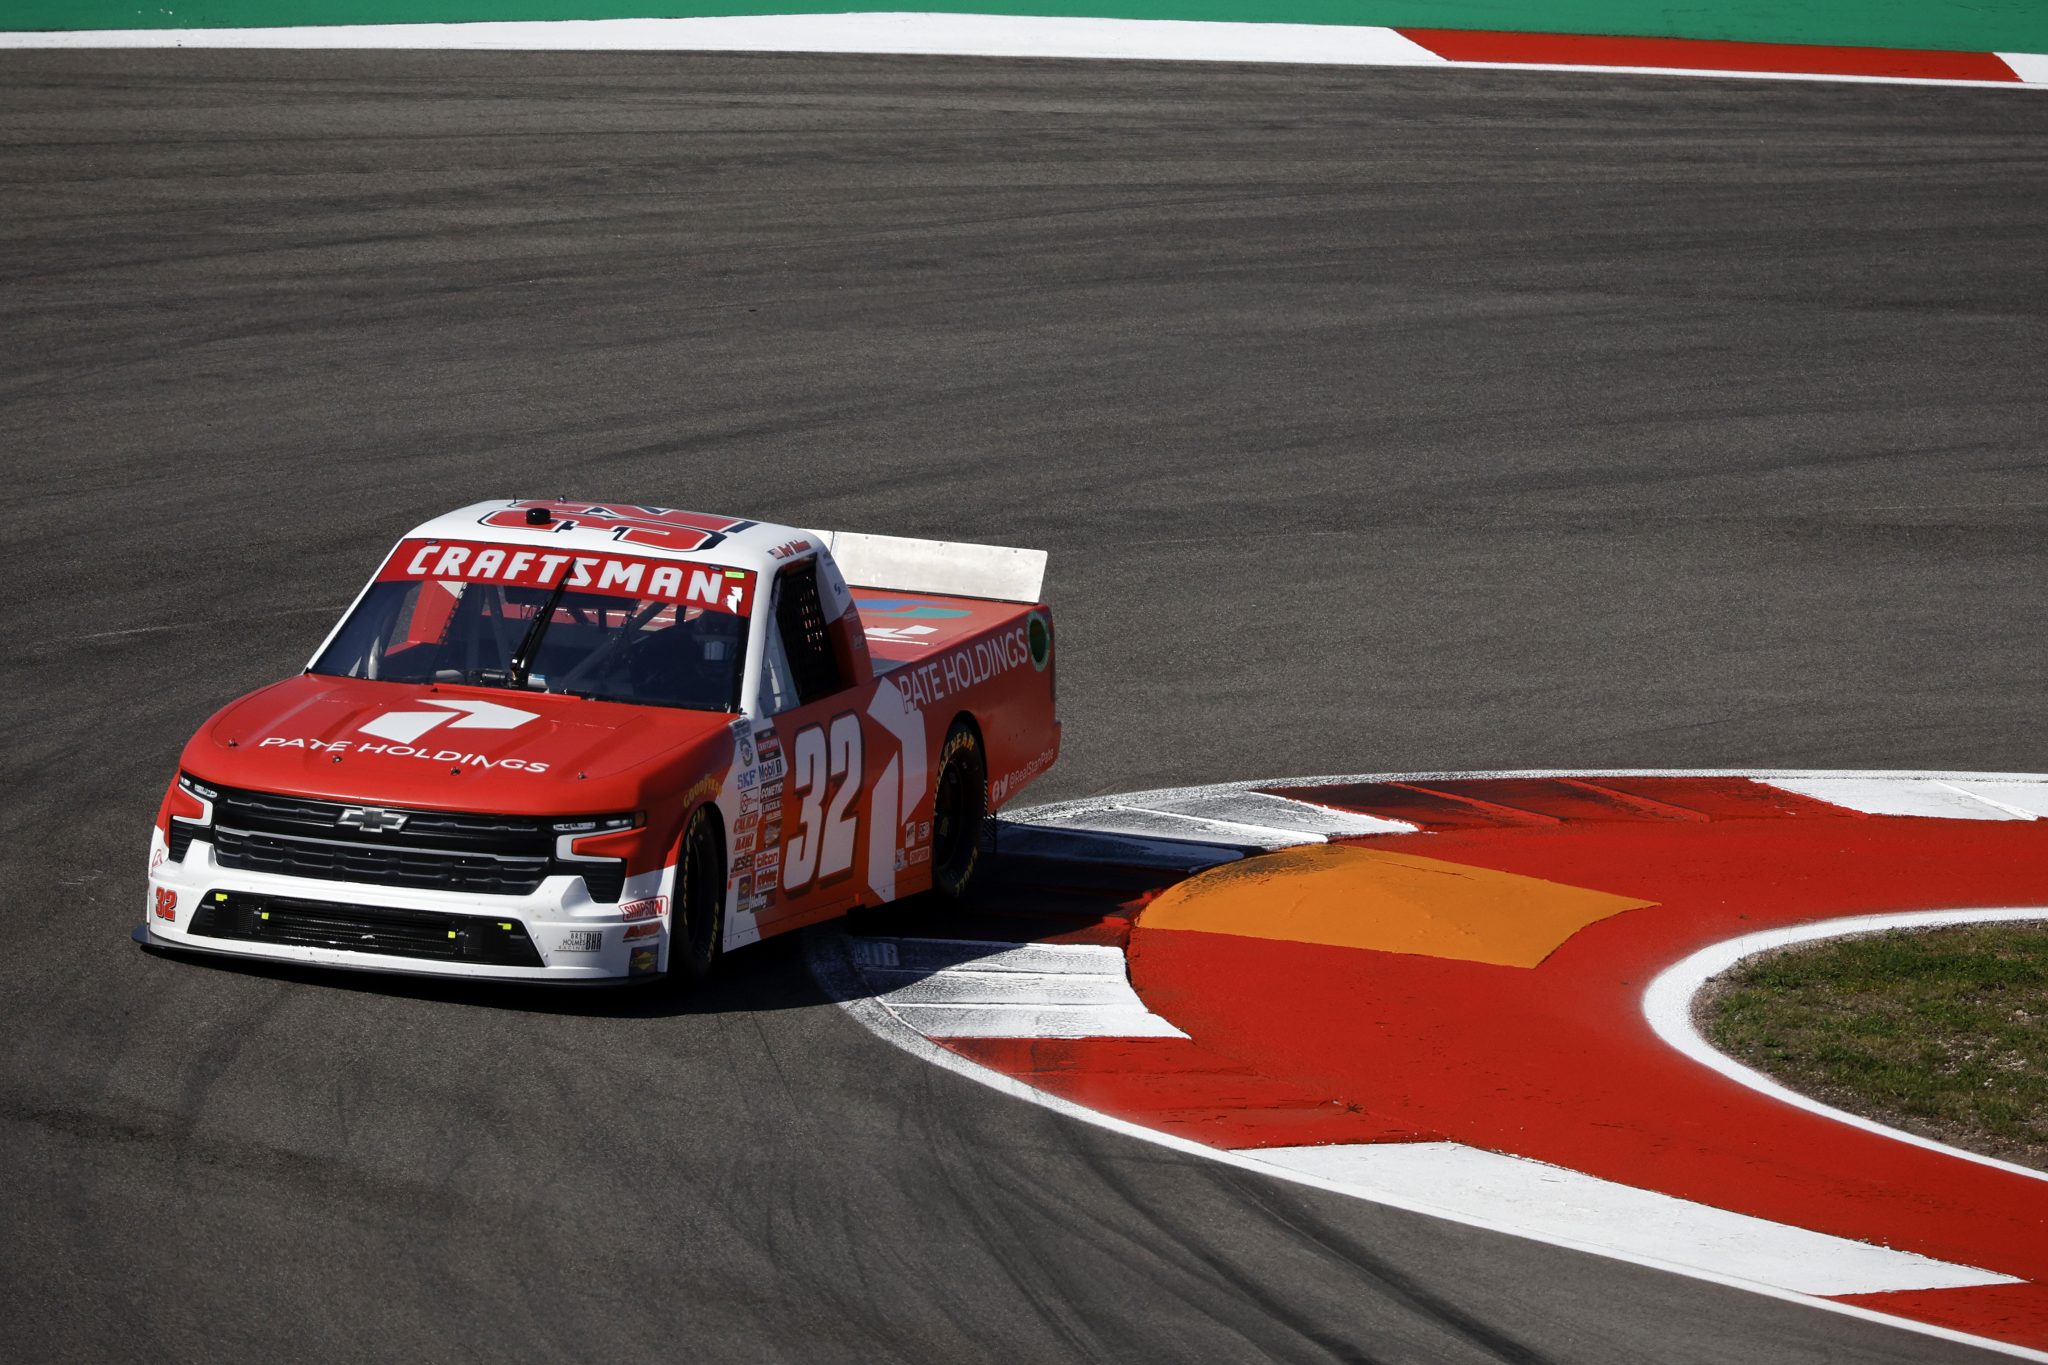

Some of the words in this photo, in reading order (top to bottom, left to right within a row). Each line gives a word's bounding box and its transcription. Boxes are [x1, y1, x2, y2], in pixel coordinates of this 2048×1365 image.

[406, 545, 723, 605] CRAFTSMAN
[898, 662, 945, 714] PATE
[942, 627, 1028, 695] HOLDINGS
[259, 737, 353, 753] PATE
[357, 742, 550, 774] HOLDINGS
[758, 761, 776, 779] Mobil
[683, 773, 722, 809] GOODYEAR
[737, 768, 757, 790] SKF
[783, 703, 862, 890] 32
[155, 886, 178, 922] 32
[624, 900, 663, 919] SIMPSON
[562, 938, 586, 946] HOLMES
[586, 932, 603, 951] BHR
